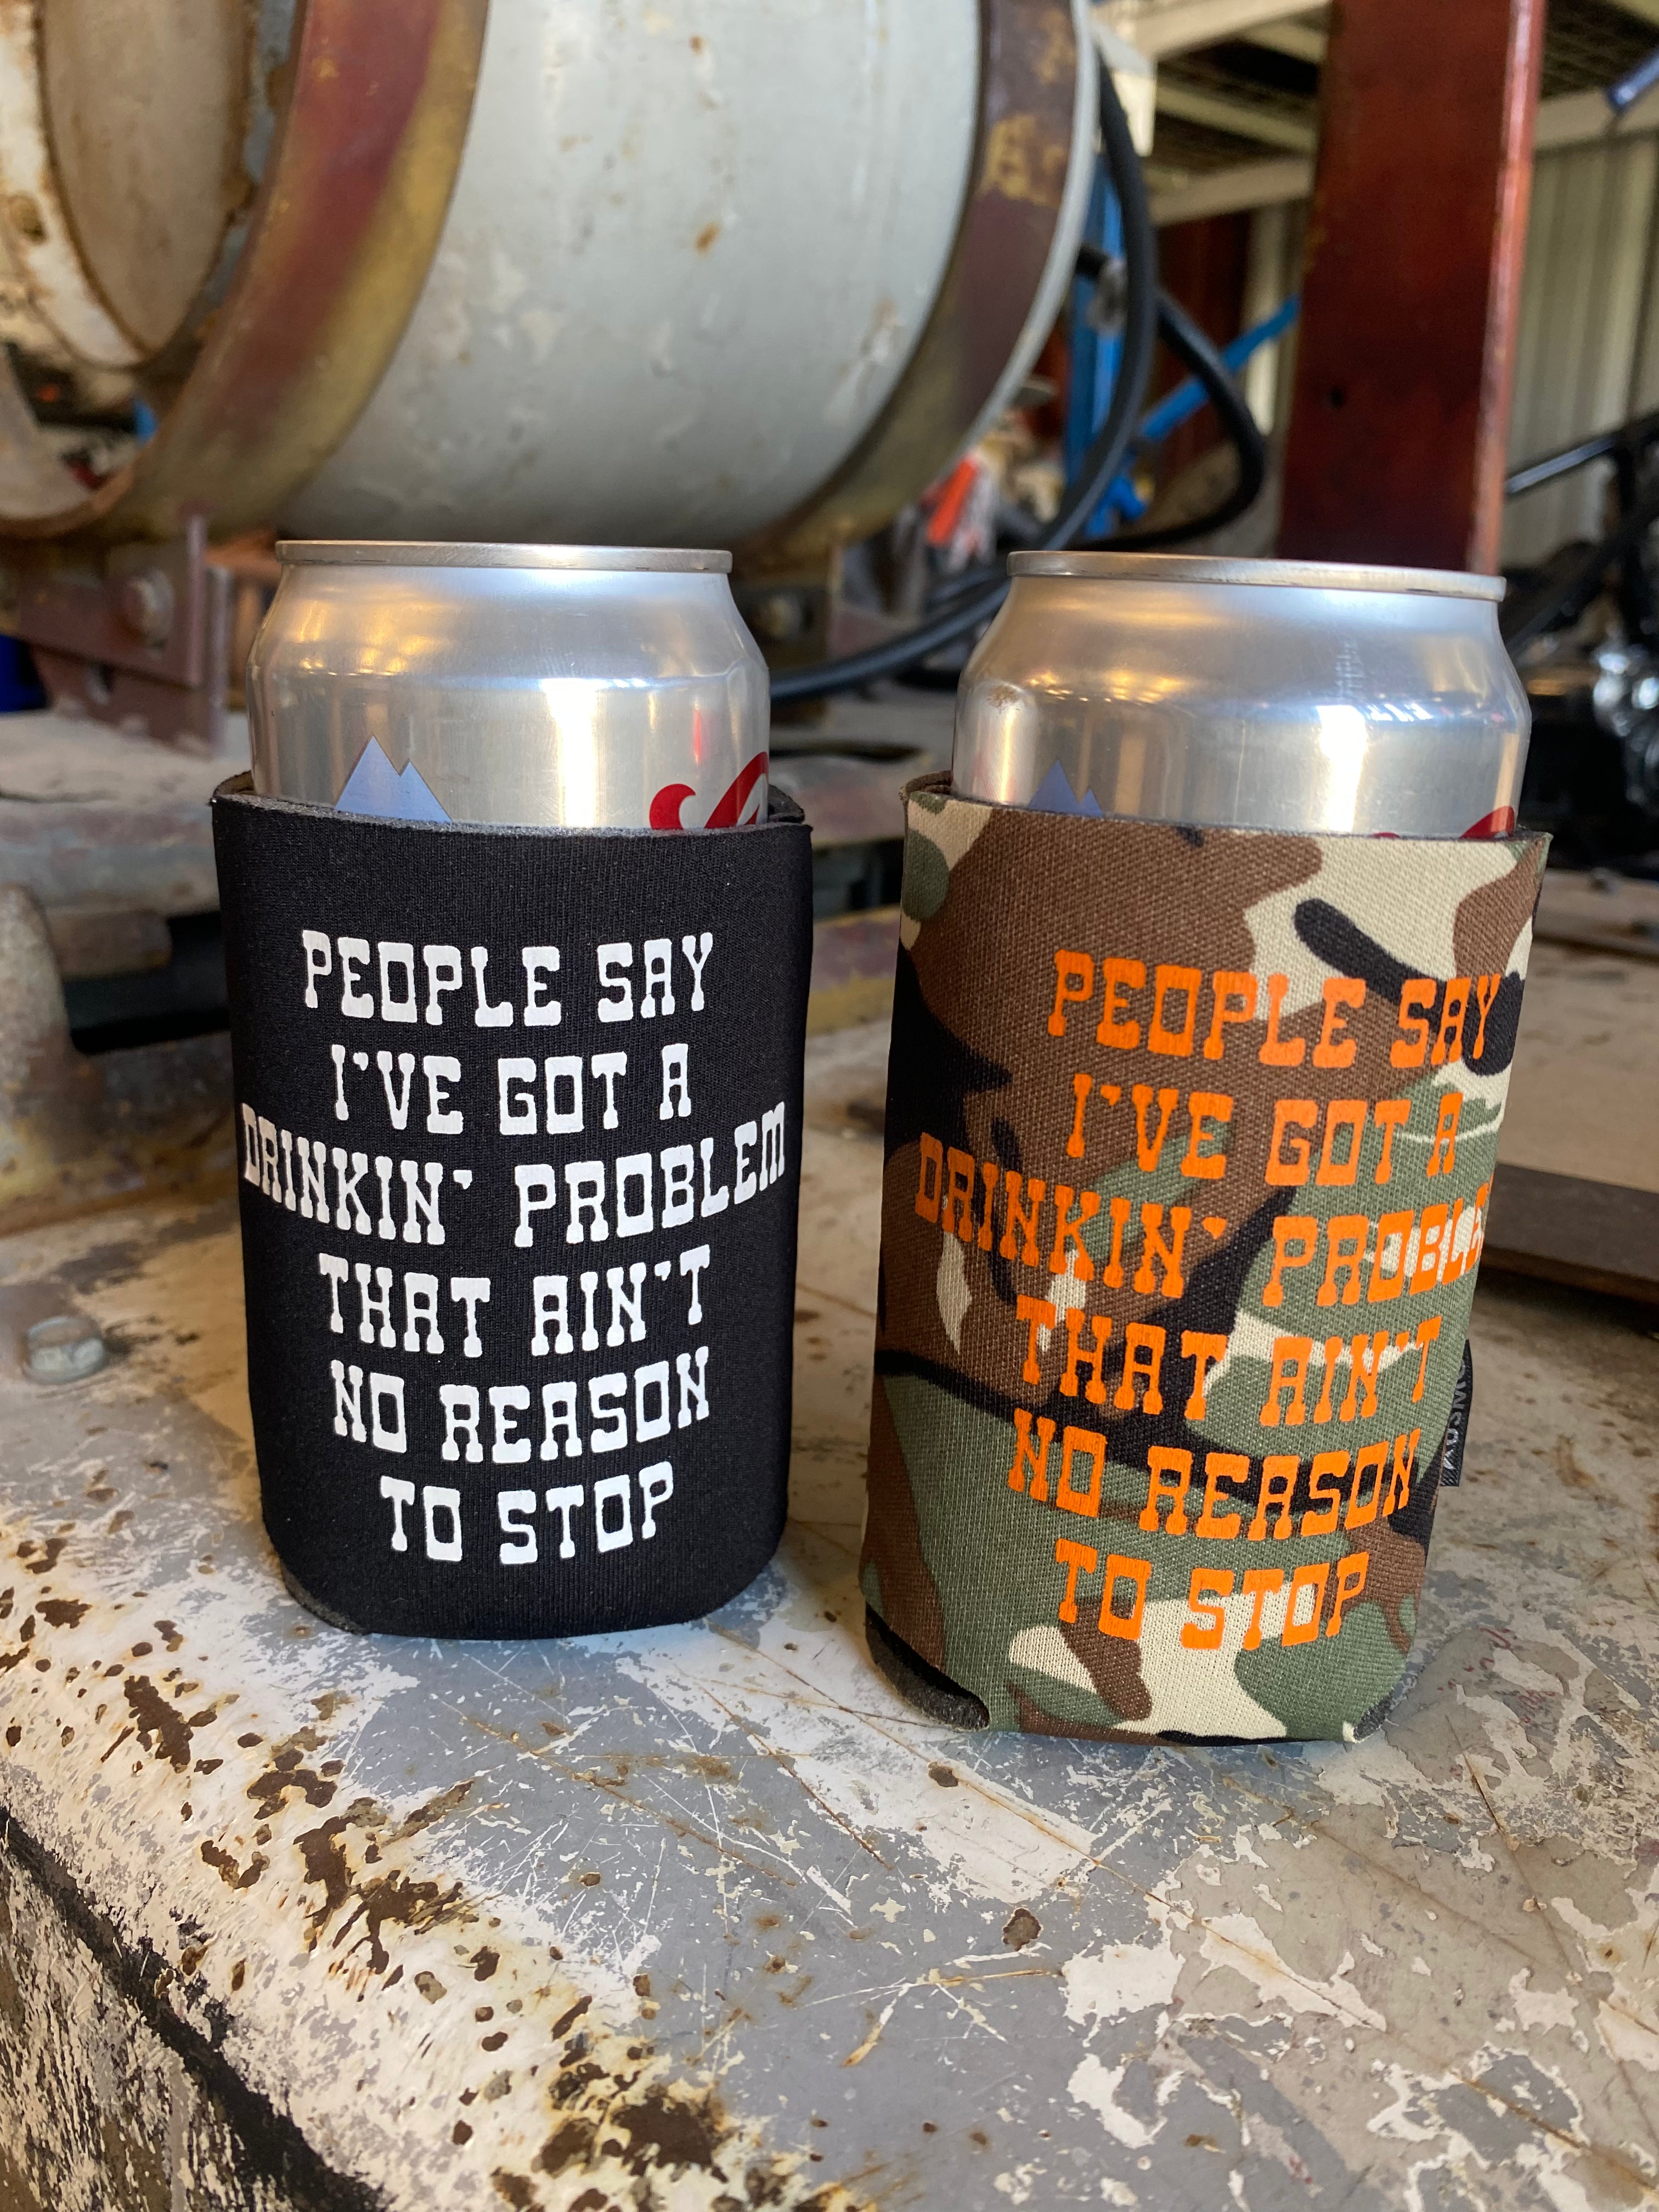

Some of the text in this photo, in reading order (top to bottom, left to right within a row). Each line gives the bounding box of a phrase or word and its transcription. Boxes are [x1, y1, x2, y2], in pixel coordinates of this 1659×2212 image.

[302, 929, 713, 1028] PEOPLE SAY
[1048, 950, 1501, 1068] PEOPLE SAY
[331, 1043, 692, 1136] I'VE GOT A
[1066, 1074, 1464, 1186] I'VE GOT A
[241, 1101, 786, 1248] DRINKIN' PROBLEM
[915, 1132, 1227, 1299] DRINKIN'
[319, 1244, 711, 1358] THAT AIN'T
[330, 1346, 710, 1464] NO REASON
[1016, 1294, 1228, 1420] THAT
[1260, 1316, 1442, 1426] AIN'T
[380, 1461, 674, 1565] TO STOP
[1008, 1408, 1421, 1541] NO REASON
[1056, 1538, 1370, 1650] TO STOP
